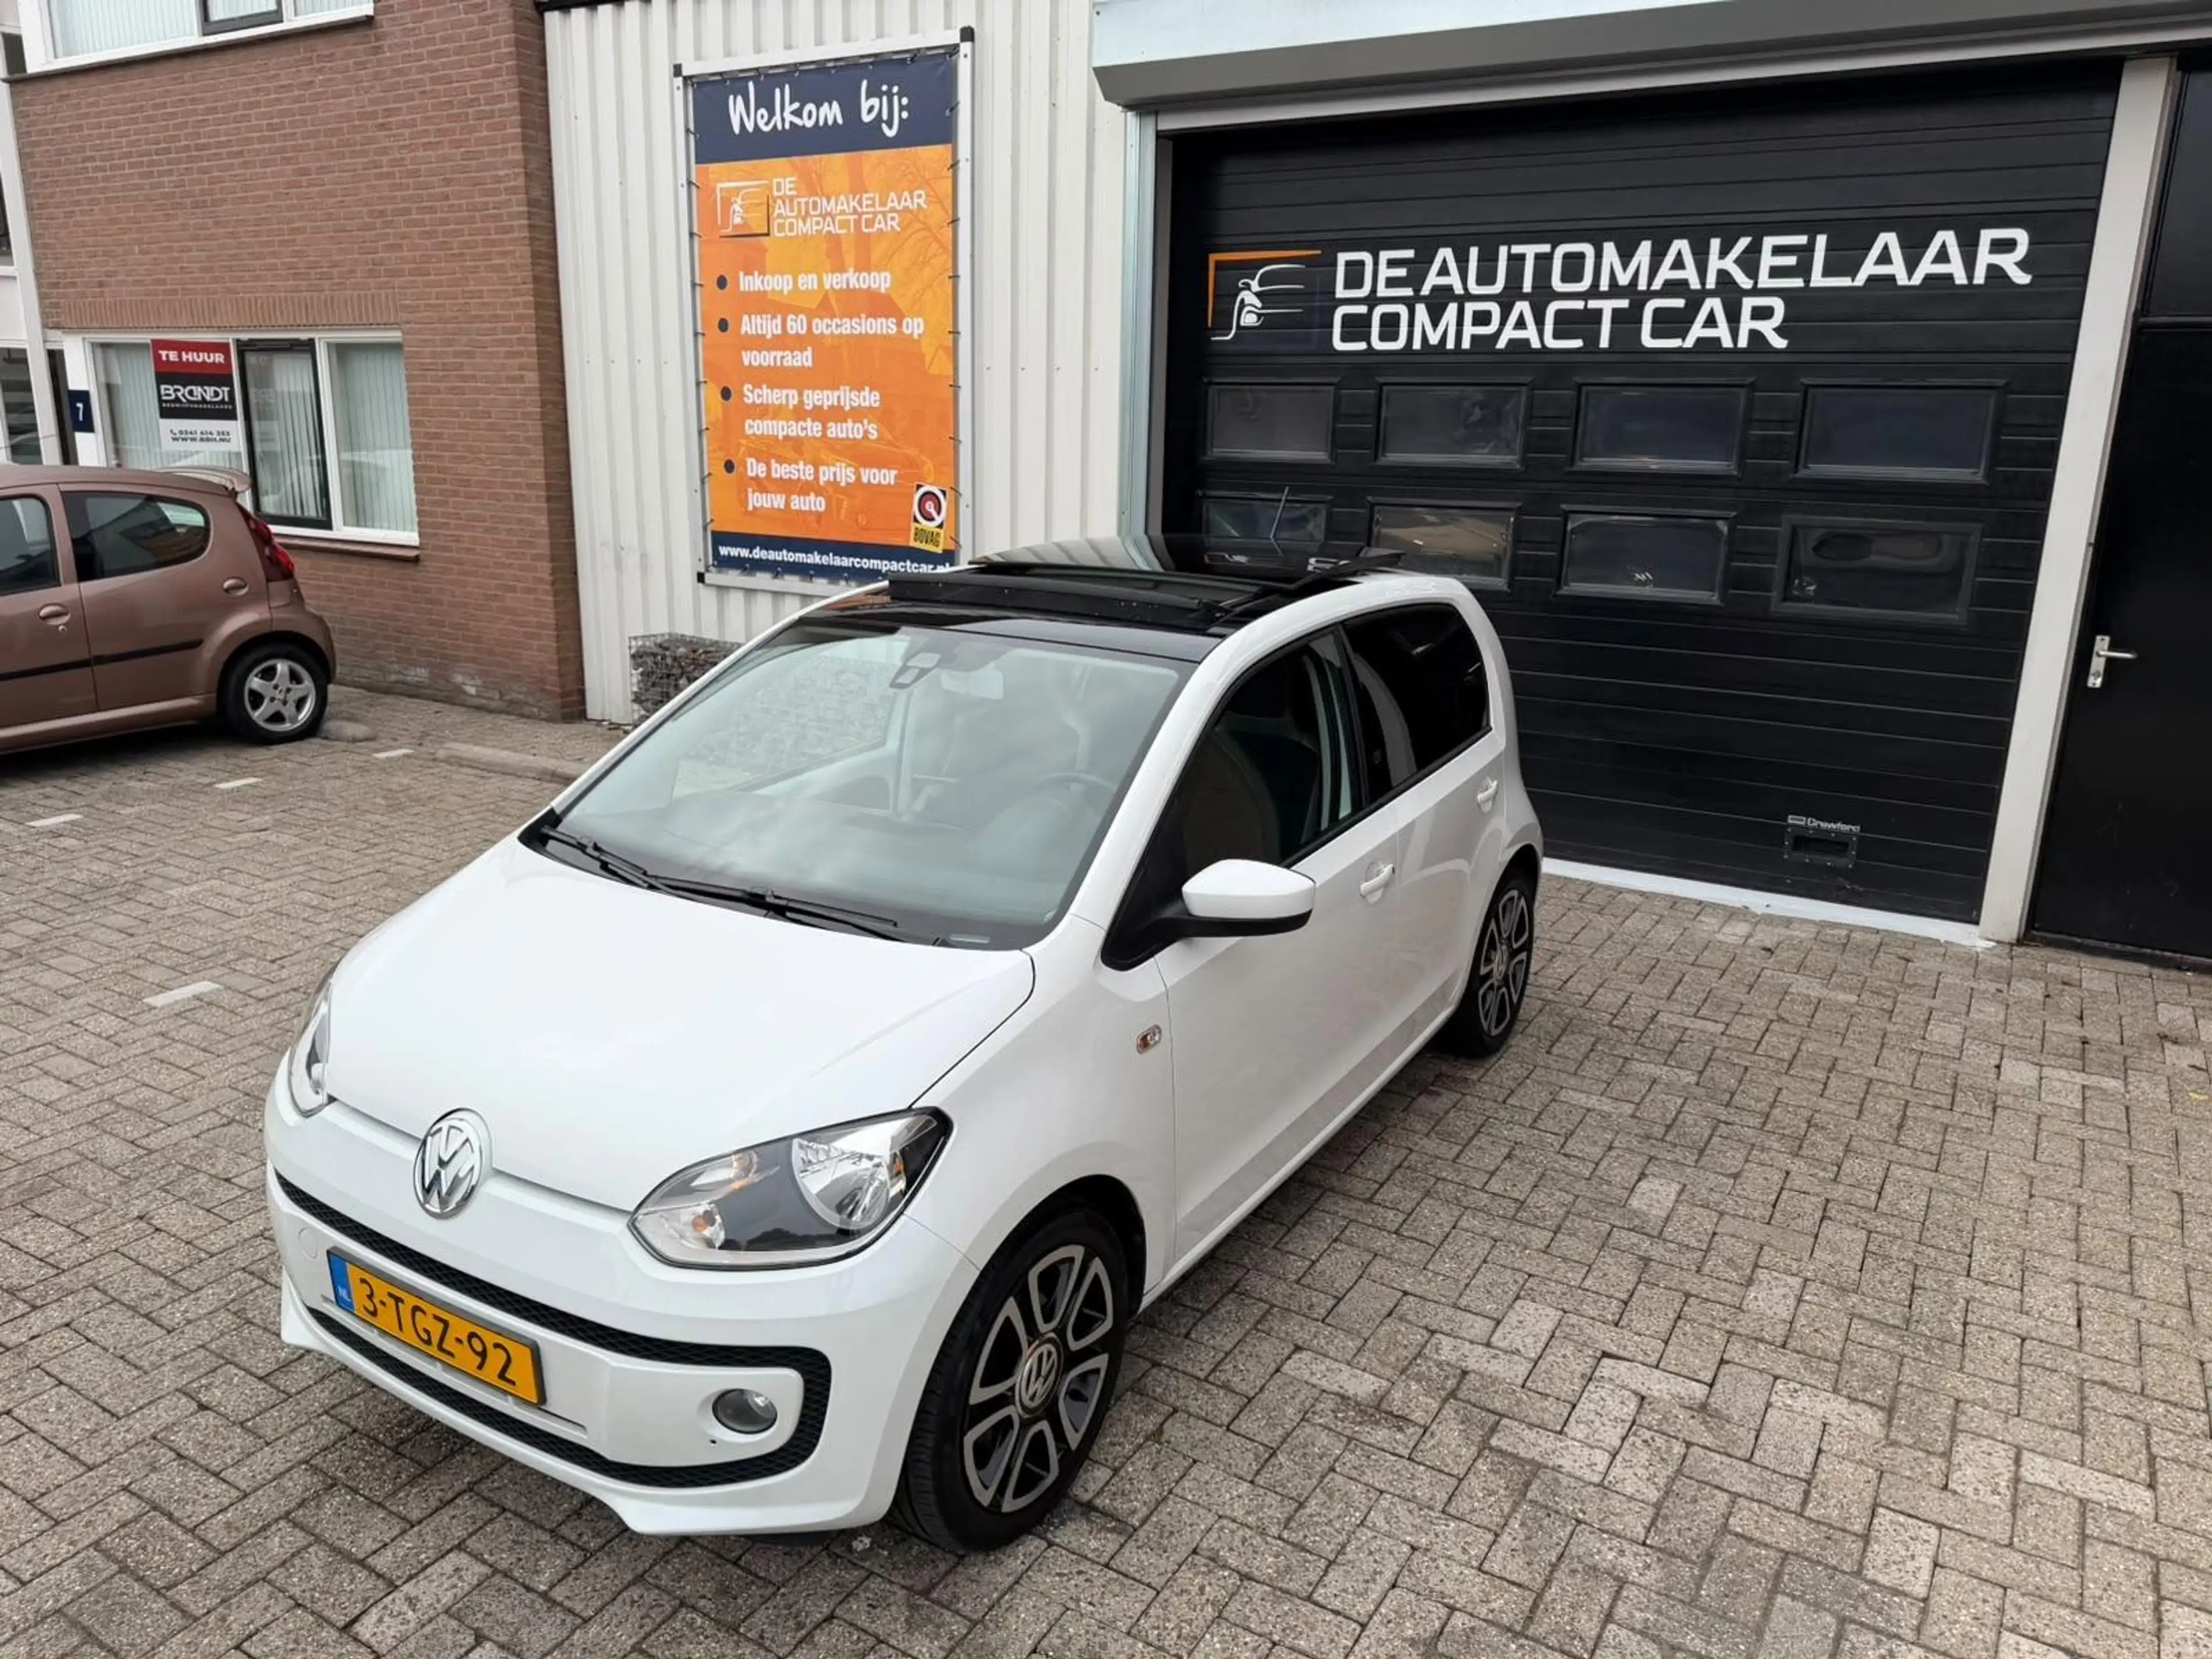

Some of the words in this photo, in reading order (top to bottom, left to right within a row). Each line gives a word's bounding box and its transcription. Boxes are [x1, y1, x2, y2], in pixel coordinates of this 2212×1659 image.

[728, 80, 843, 135] Welkom
[860, 78, 909, 138] bij:
[772, 176, 797, 197] DE
[773, 190, 928, 217] AUTOMAKELAAR
[773, 214, 858, 237] COMPACT
[861, 213, 900, 233] CAR
[1334, 248, 1415, 299] DE
[1419, 228, 2033, 296] AUTOMAKELAAR
[739, 271, 793, 294] Inkoop
[798, 274, 818, 290] en
[824, 268, 892, 294] verkoop
[740, 314, 782, 339] Altijd
[786, 315, 807, 335] 60
[812, 314, 897, 335] occasions
[902, 316, 925, 339] op
[1332, 298, 1630, 351] COMPACT
[1640, 296, 1789, 349] CAR
[158, 350, 180, 362] TE
[181, 351, 225, 364] HUUR
[741, 347, 813, 368] voorraad
[160, 384, 230, 403] BRANDT
[743, 384, 798, 408] Scherp
[802, 386, 881, 411] geprijsde
[75, 402, 84, 422] 7
[744, 418, 823, 441] compacte
[826, 419, 878, 440] auto's
[746, 457, 766, 478] De
[771, 459, 814, 480] beste
[819, 460, 856, 487] prijs
[859, 468, 899, 486] voor
[747, 488, 786, 512] jouw
[790, 492, 827, 513] auto
[718, 544, 952, 575] www.deautomakelaarcompactcar
[359, 1277, 517, 1388] 3-TGZ-92
